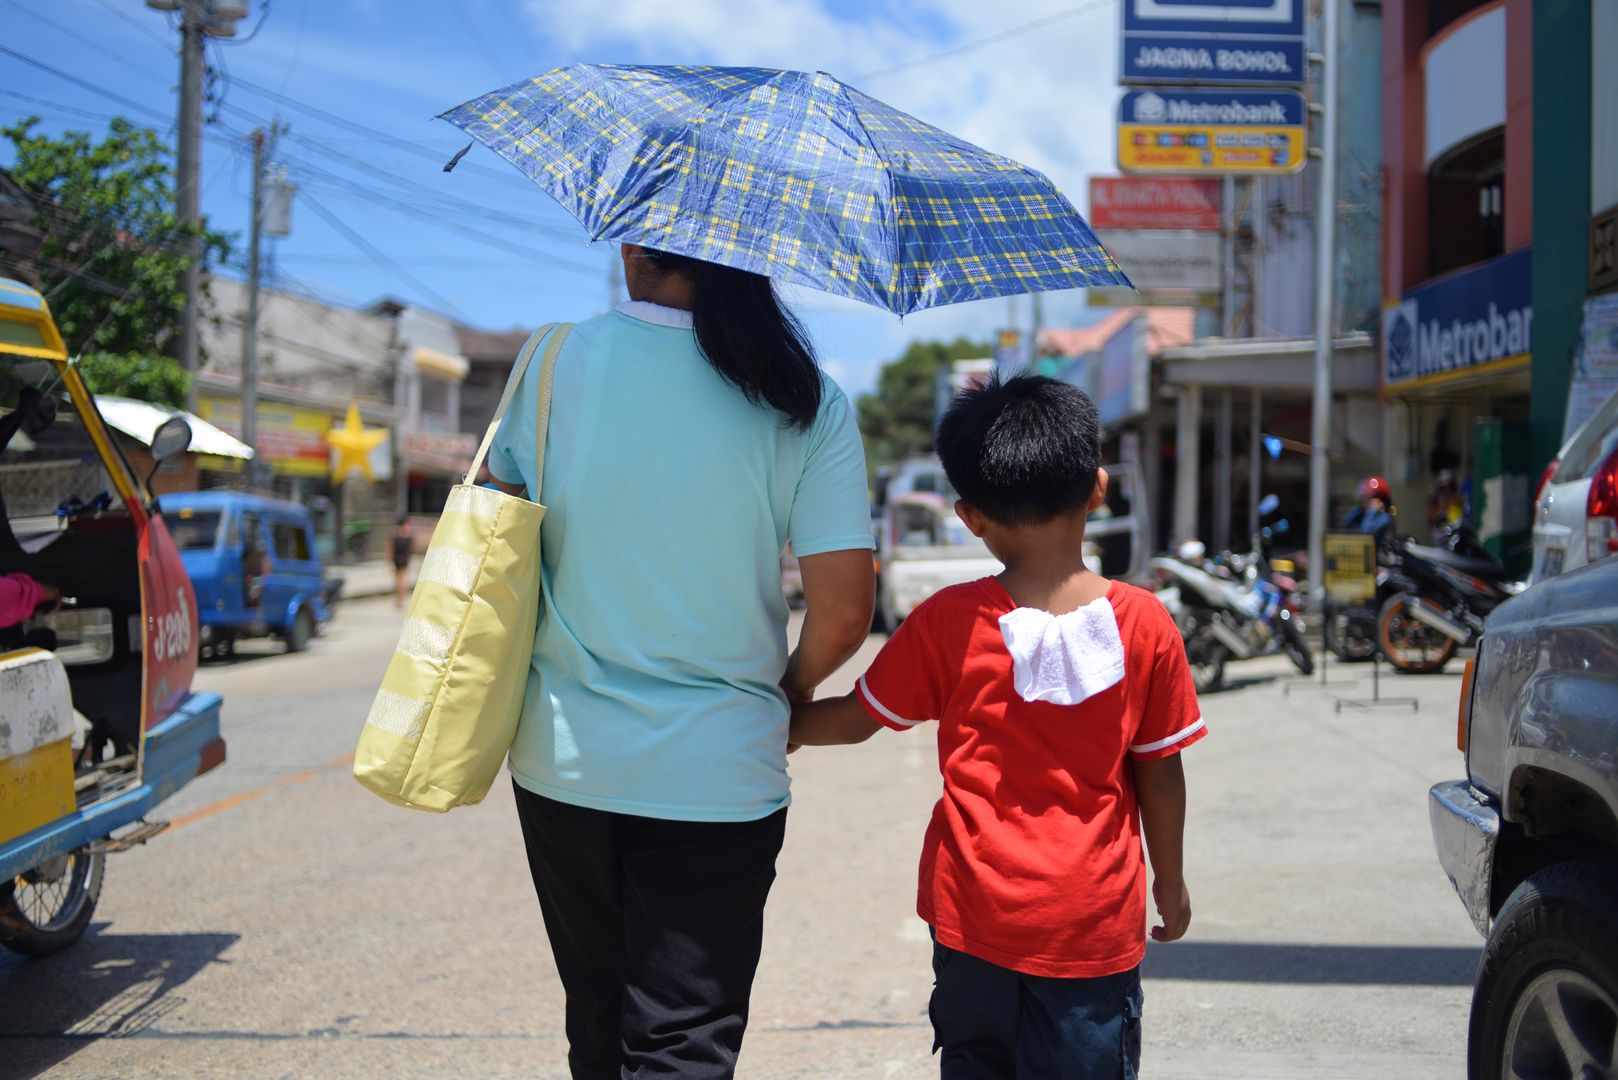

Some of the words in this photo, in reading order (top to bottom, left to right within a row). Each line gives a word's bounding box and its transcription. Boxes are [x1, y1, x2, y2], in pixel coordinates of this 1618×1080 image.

[1135, 46, 1214, 70] JAGNA
[1216, 50, 1292, 73] BOHOL
[1169, 99, 1287, 123] Metrobank
